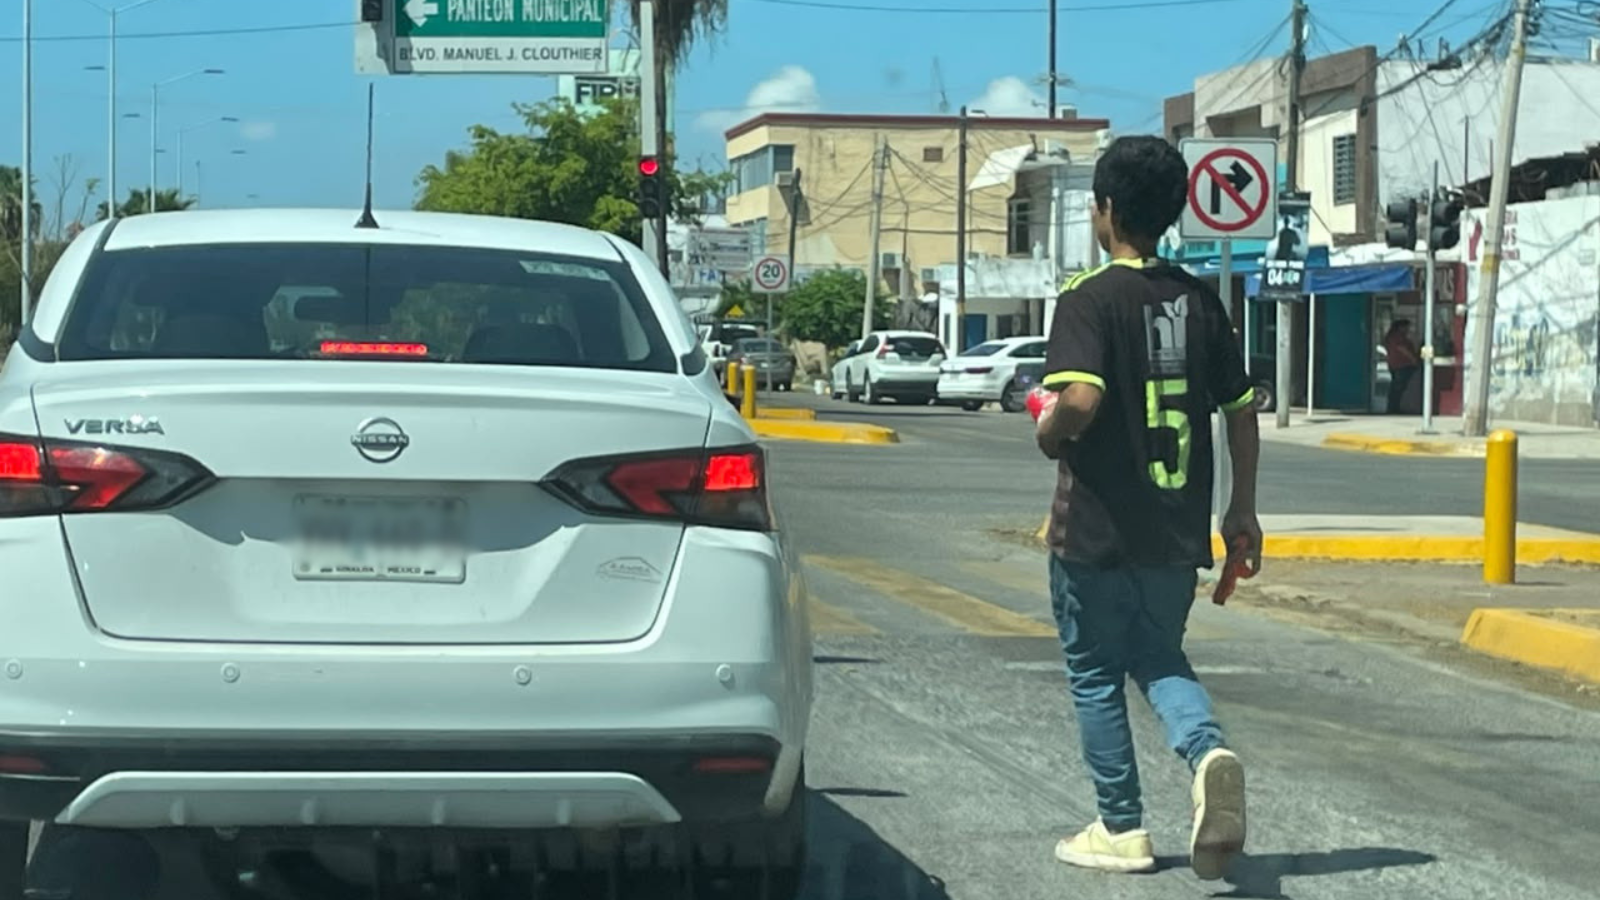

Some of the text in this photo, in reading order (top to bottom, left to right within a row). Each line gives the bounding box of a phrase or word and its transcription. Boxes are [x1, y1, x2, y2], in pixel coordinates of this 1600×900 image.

[521, 0, 602, 22] MUNICIPAL
[399, 47, 602, 61] BLVD. MANUEL J. CLOUTHIER
[762, 264, 781, 279] 20
[64, 418, 165, 435] VERSA
[1146, 379, 1191, 489] 5
[351, 434, 408, 444] NISSAN
